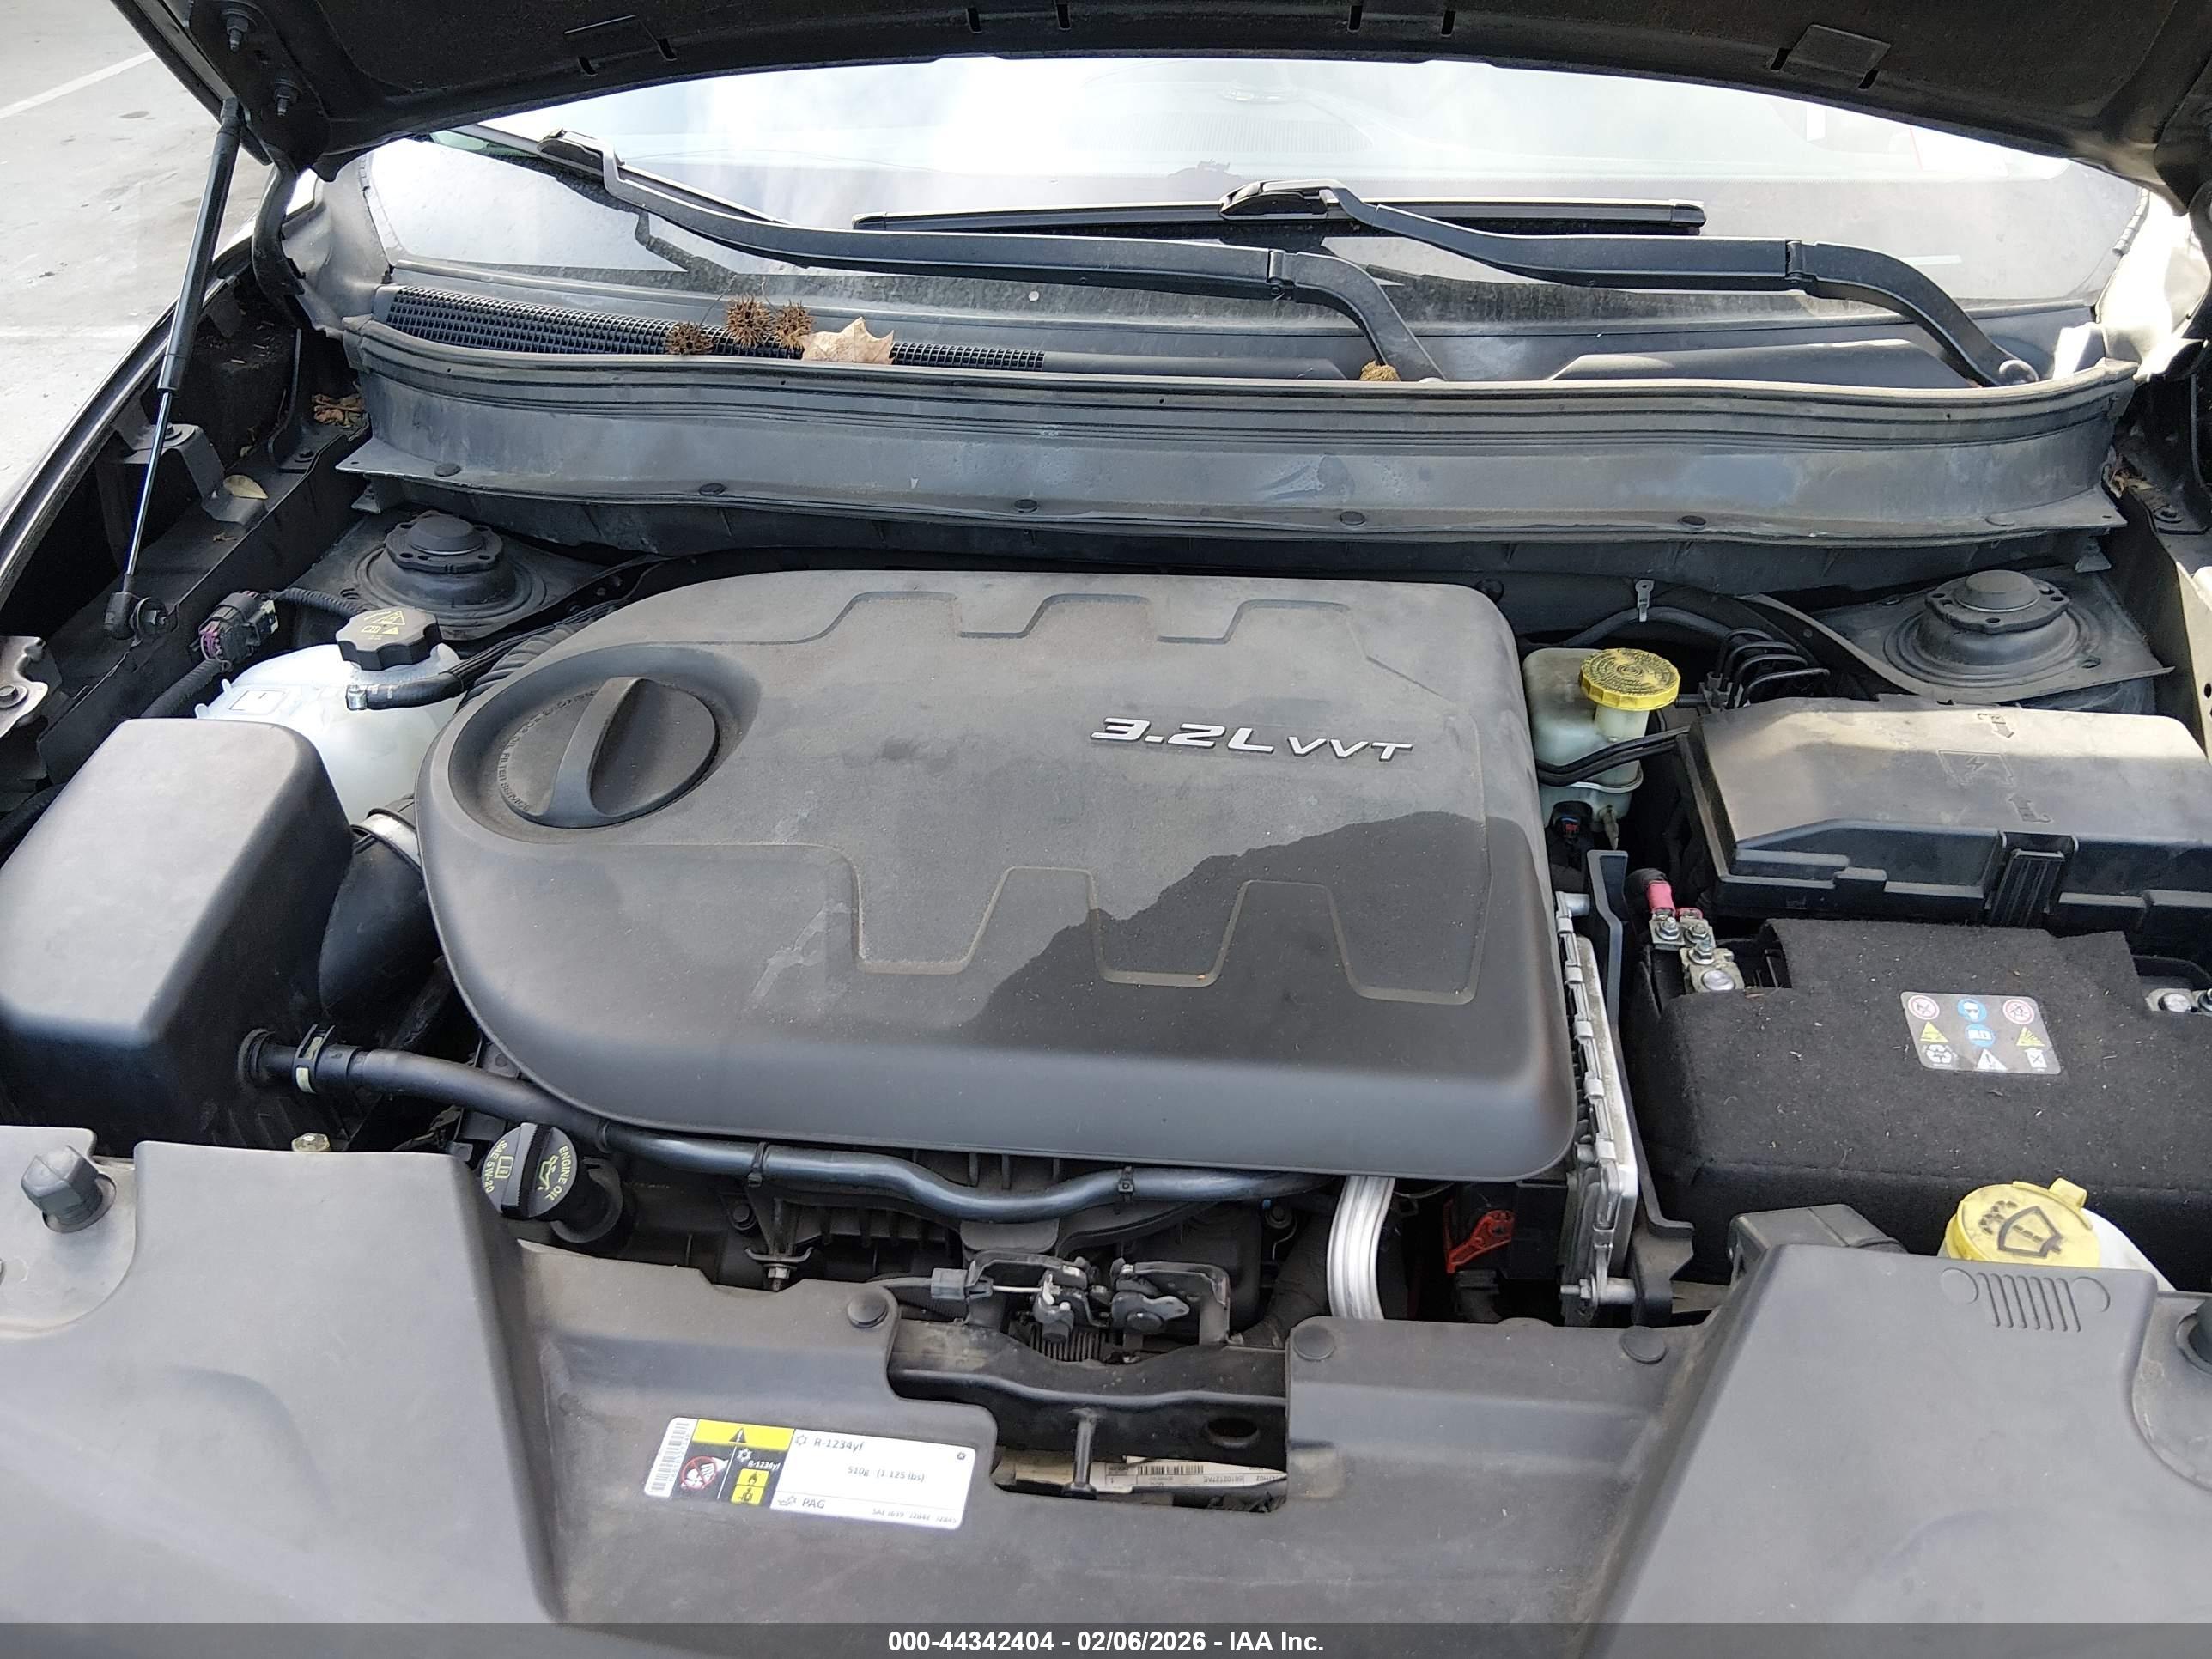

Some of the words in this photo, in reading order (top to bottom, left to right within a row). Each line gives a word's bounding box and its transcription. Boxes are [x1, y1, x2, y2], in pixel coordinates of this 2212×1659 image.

[1090, 717, 1275, 755] 3.2L
[1287, 735, 1414, 763] VVT
[490, 1139, 508, 1160] SAE
[557, 1145, 573, 1185] ENGINE
[483, 1161, 496, 1194] 5W-20
[544, 1185, 563, 1201] OIL
[813, 1437, 865, 1452] R-1234yf
[747, 1460, 781, 1472] R-1234yf
[847, 1466, 870, 1478] 510g
[801, 1498, 826, 1510] PAG
